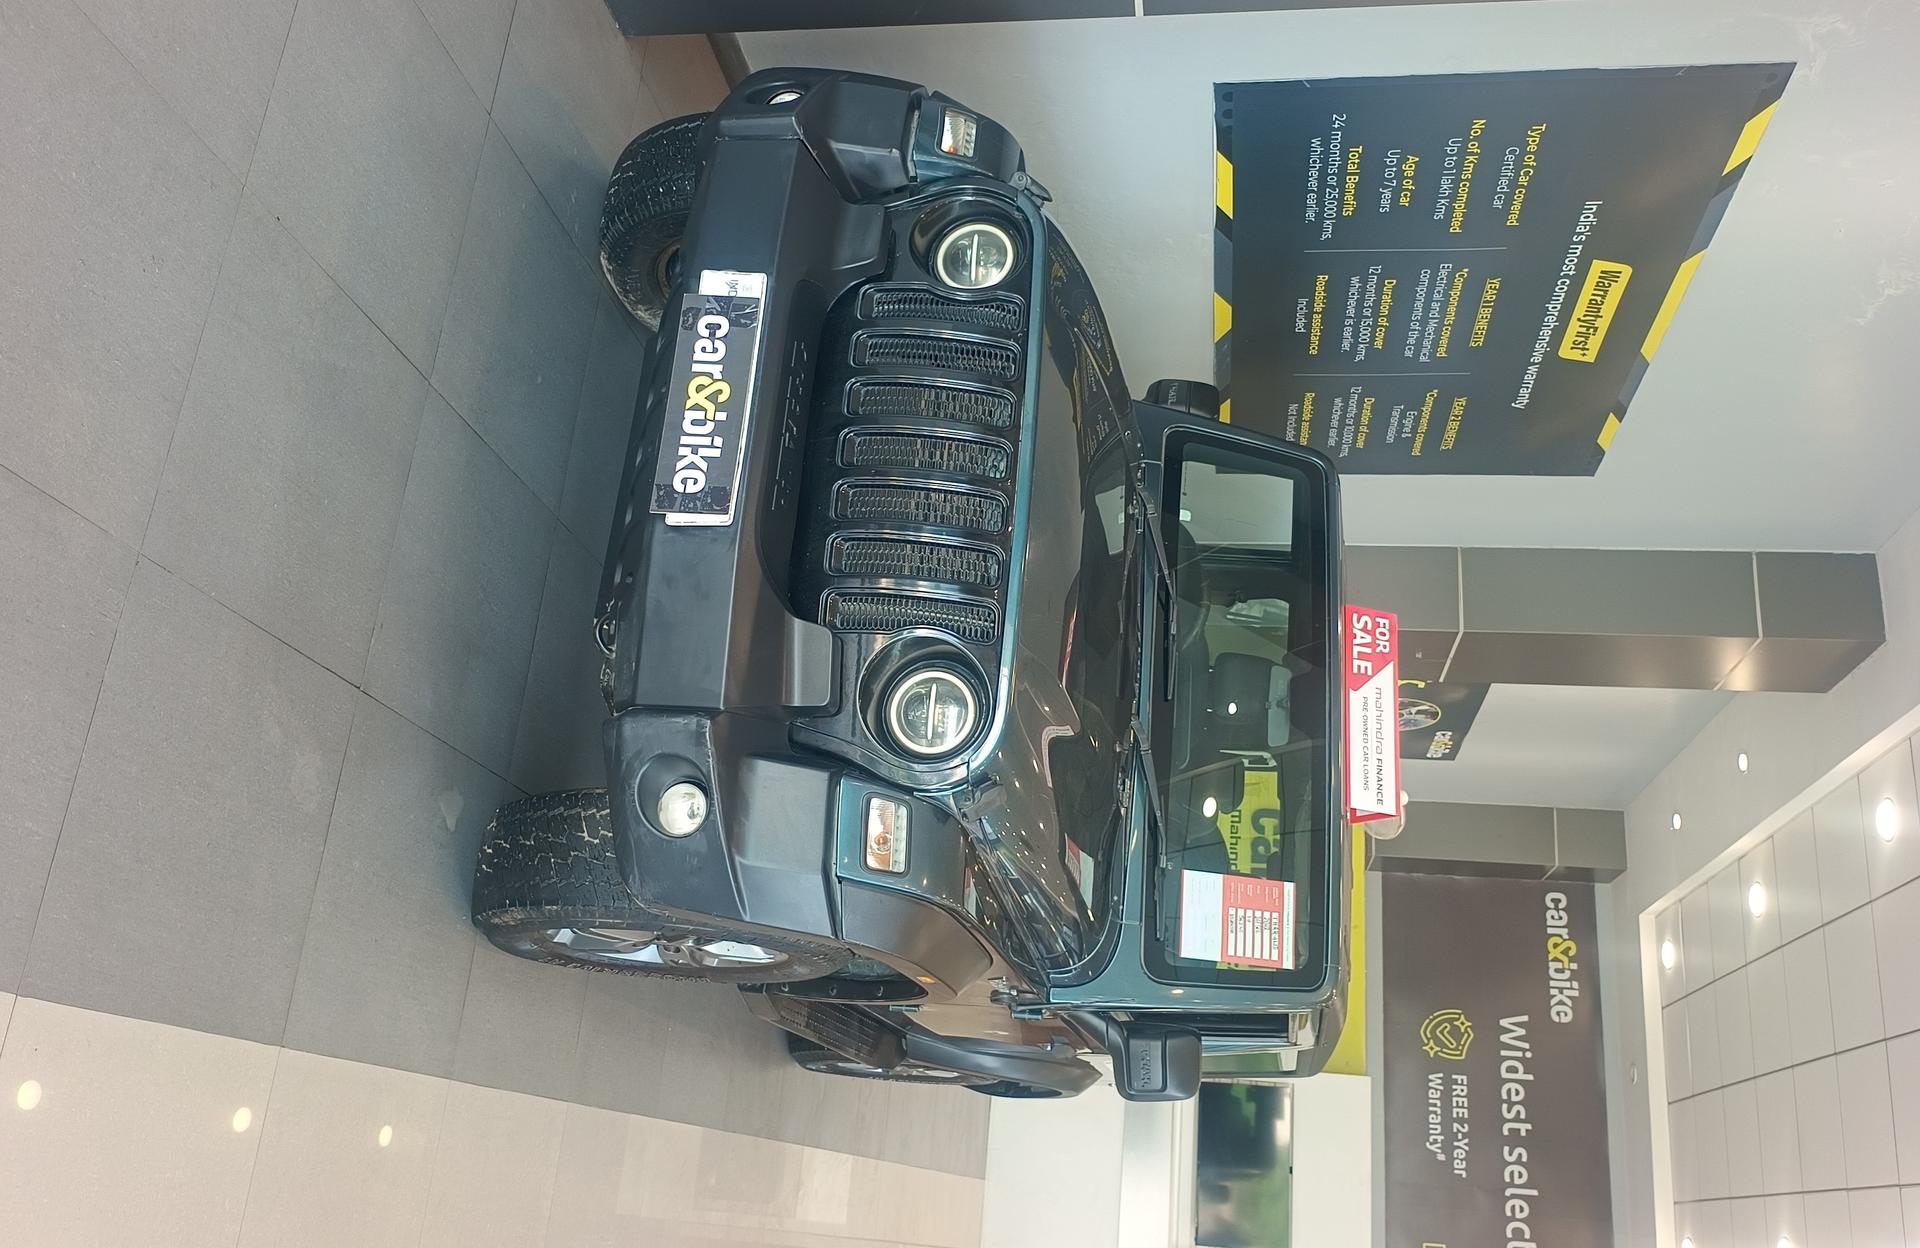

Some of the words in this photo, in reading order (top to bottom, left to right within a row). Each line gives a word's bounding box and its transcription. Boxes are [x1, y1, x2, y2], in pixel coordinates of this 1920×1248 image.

[1332, 114, 1346, 128] 24
[1470, 119, 1486, 138] No.
[1445, 138, 1462, 154] Up
[1467, 142, 1480, 153] of
[1526, 124, 1546, 151] Type
[1308, 138, 1324, 191] whichever
[1327, 131, 1342, 173] months
[1347, 146, 1362, 172] Total
[1384, 150, 1401, 165] Up
[1444, 157, 1456, 167] to
[1523, 155, 1536, 166] of
[1385, 168, 1396, 178] to
[1402, 155, 1419, 176] Age
[1462, 156, 1478, 179] Kms
[1497, 147, 1519, 191] Certified
[1518, 168, 1533, 186] Car
[1327, 176, 1336, 186] or
[1402, 179, 1415, 189] of
[1438, 176, 1454, 196] lakh
[1305, 193, 1319, 223] earlier.
[1323, 188, 1339, 218] 25,000
[1342, 176, 1358, 216] Benefits
[1380, 188, 1392, 212] years
[1400, 192, 1409, 206] car
[1449, 182, 1470, 232] completed
[1492, 194, 1505, 208] car
[1507, 188, 1526, 225] covered
[1434, 200, 1450, 219] Kms
[1572, 201, 1602, 241] India's
[1320, 220, 1335, 240] kms,
[1560, 245, 1583, 276] most
[1314, 275, 1328, 312] Roadside
[1364, 276, 1378, 306] months
[1411, 269, 1431, 320] components
[1433, 264, 1452, 300] Electrical
[1483, 278, 1501, 300] YEAR
[1346, 276, 1361, 317] whichever
[1379, 280, 1396, 315] Duration
[1428, 302, 1440, 317] and
[1296, 299, 1308, 332] Included
[1363, 308, 1372, 316] or
[1379, 318, 1388, 326] of
[1530, 279, 1571, 362] comprehensive
[1309, 314, 1322, 354] assistance
[1359, 318, 1373, 342] 15,000
[1374, 328, 1384, 349] cover
[1407, 331, 1419, 344] the
[1410, 322, 1421, 330] of
[1471, 308, 1492, 347] BENEFITS
[1340, 327, 1353, 352] earlier.
[1404, 346, 1414, 357] car
[1419, 320, 1439, 362] Mechanical
[1436, 326, 1451, 356] covered
[1354, 344, 1369, 362] kms,
[1511, 365, 1540, 409] warranty
[672, 314, 731, 494] car&bike
[1288, 404, 1298, 415] Not
[1302, 393, 1315, 421] Roadside
[1330, 398, 1344, 428] whichever
[1346, 394, 1358, 417] months
[1360, 398, 1375, 424] Duration
[1453, 397, 1467, 415] YEAR
[1286, 416, 1297, 440] Included
[1386, 405, 1404, 443] Transmission
[1403, 411, 1417, 432] Engine
[1356, 433, 1365, 448] cover
[1412, 434, 1424, 455] covered
[1442, 422, 1459, 449] BENEFITS
[1352, 613, 1372, 675] SALE
[1375, 617, 1389, 653] FOR
[1376, 688, 1384, 754] mahindra
[1545, 892, 1580, 1023] car&bike
[1499, 1015, 1534, 1135] Widest
[1452, 1074, 1468, 1118] FREE
[1426, 1073, 1445, 1160] Warranty#
[1452, 1122, 1469, 1177] 2-Year
